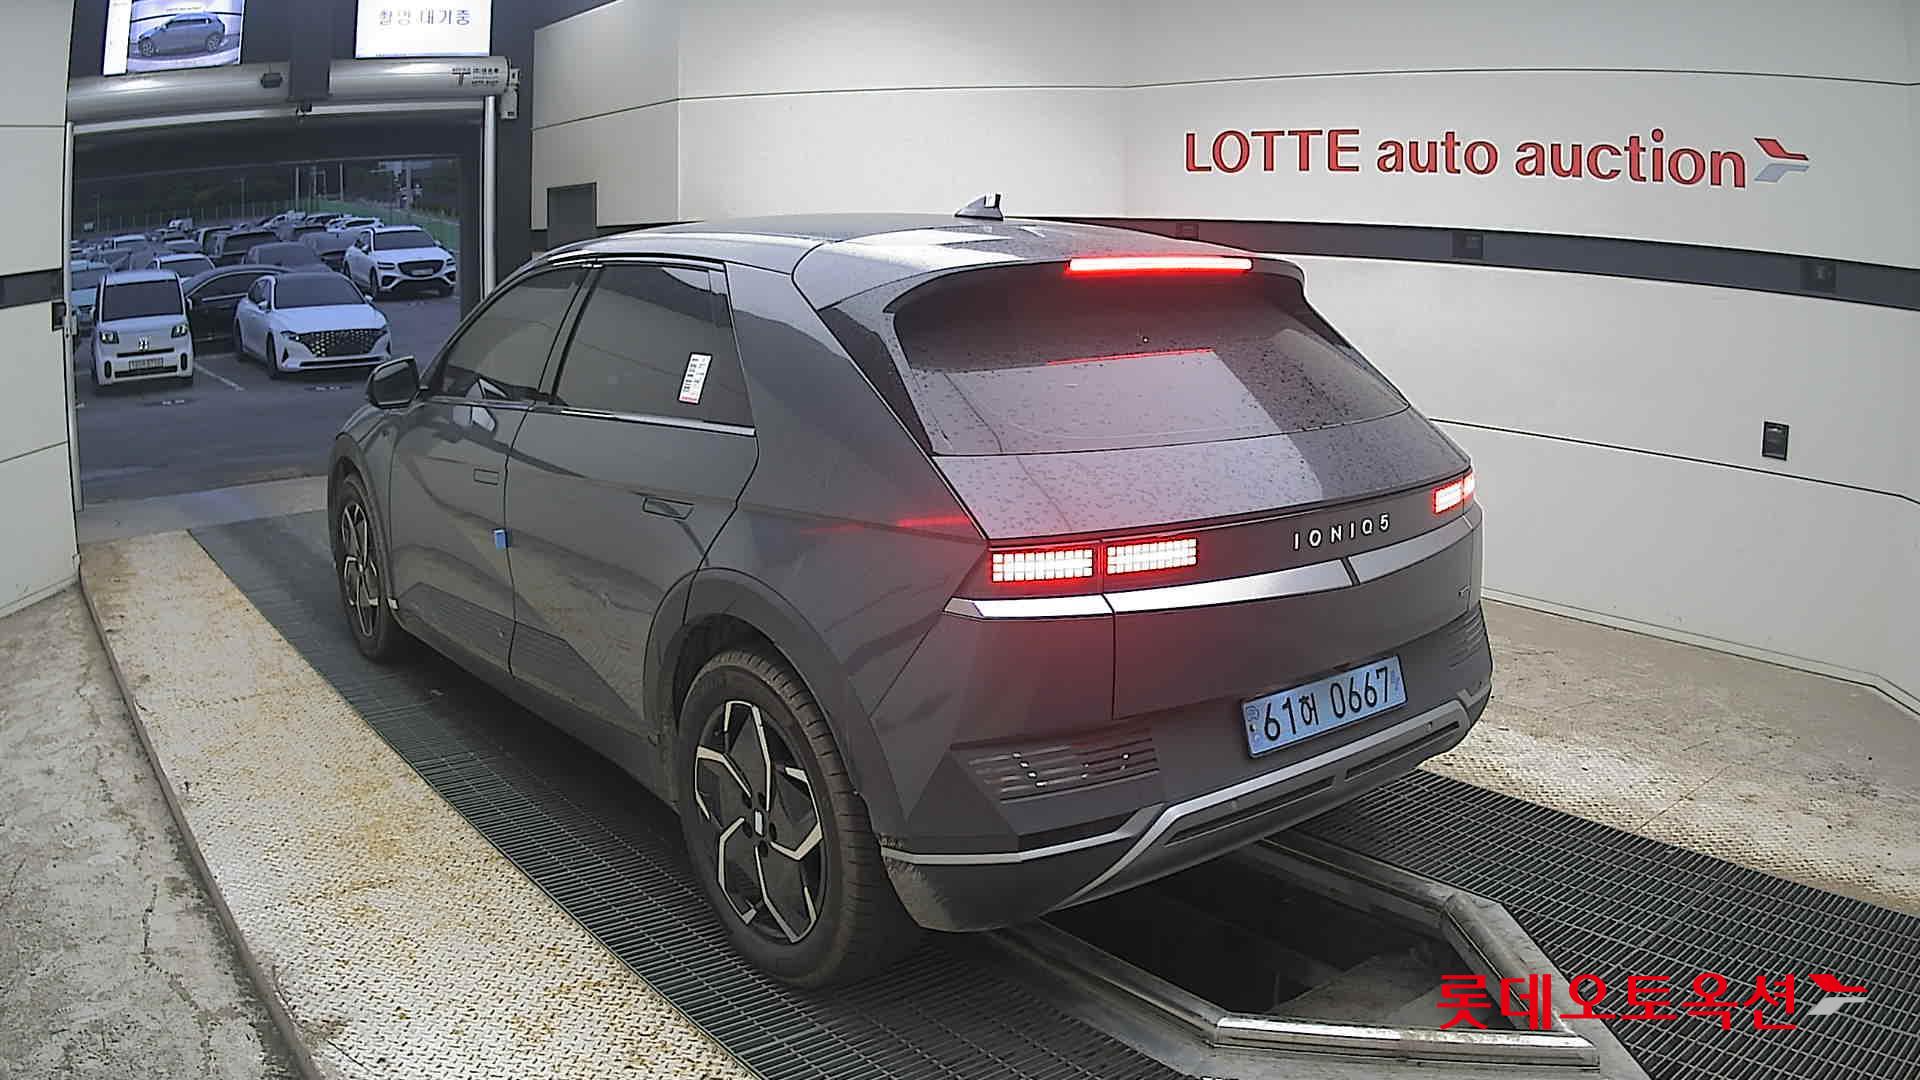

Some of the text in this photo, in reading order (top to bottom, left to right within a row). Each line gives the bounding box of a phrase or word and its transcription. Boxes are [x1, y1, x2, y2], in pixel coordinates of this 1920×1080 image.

[1184, 127, 1747, 189] LOTTE auto auction
